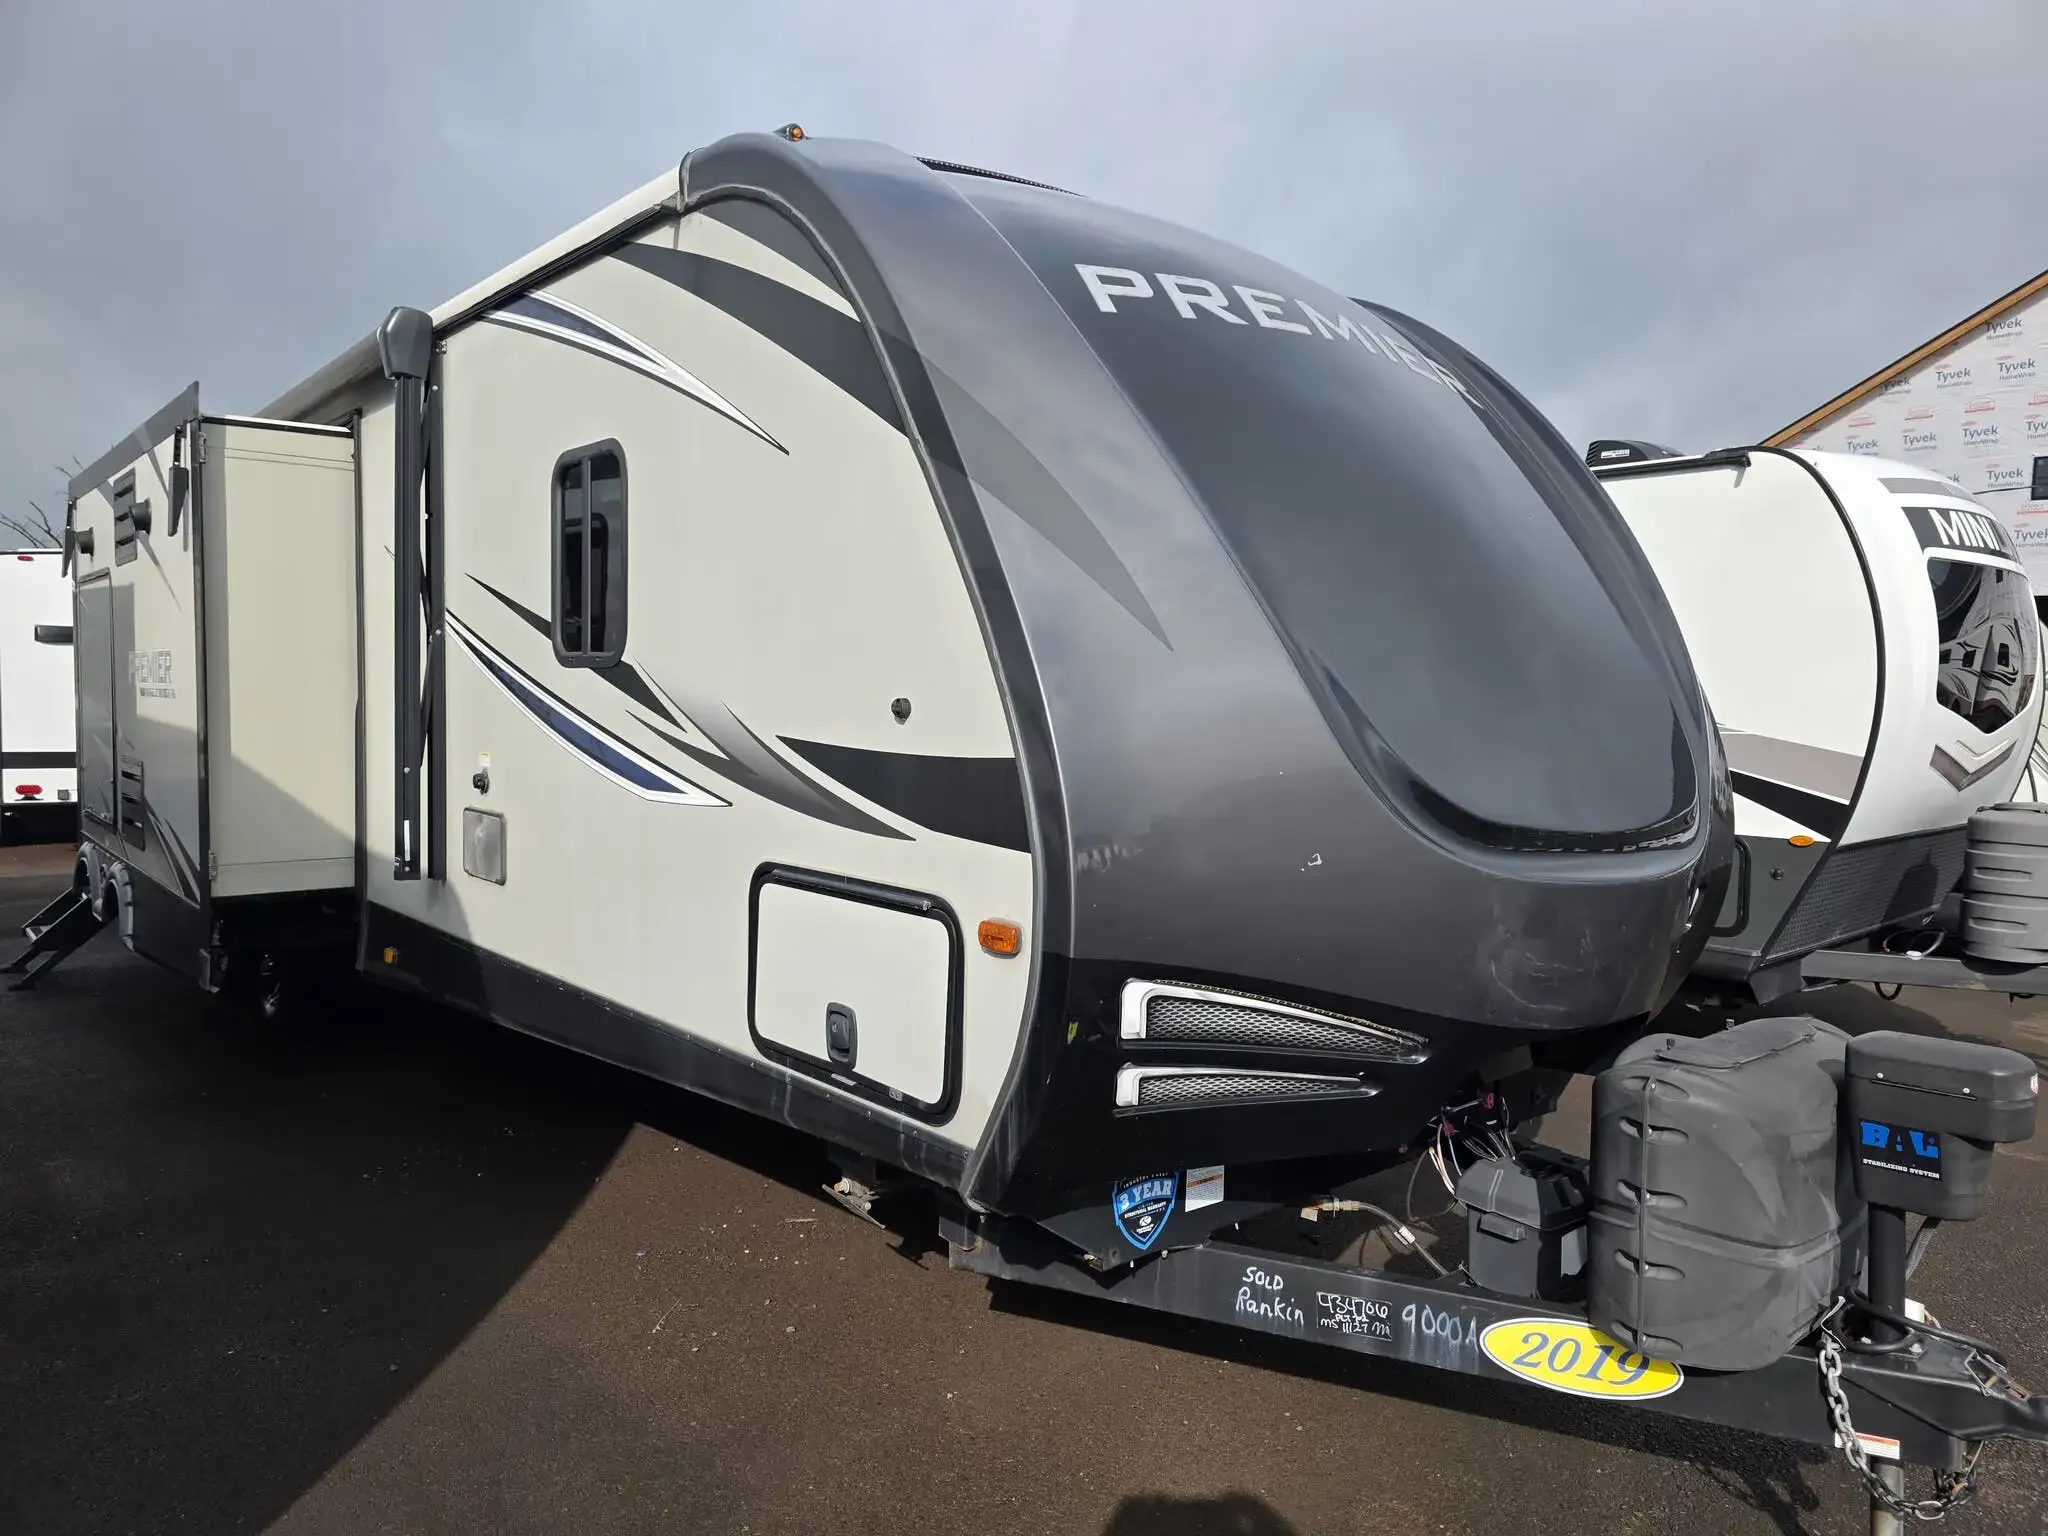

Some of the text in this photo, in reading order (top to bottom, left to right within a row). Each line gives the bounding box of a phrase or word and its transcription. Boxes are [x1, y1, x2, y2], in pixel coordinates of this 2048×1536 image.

[1985, 318, 2023, 333] Tyvek
[1075, 264, 1484, 409] PREMIER
[1997, 358, 2035, 374] Tyvek
[1936, 368, 1971, 383] Tyvek
[1882, 376, 1910, 391] yvek
[1962, 424, 1999, 440] Tyvek
[2026, 420, 2048, 433] Tyv
[1903, 431, 1937, 446] Tyvek
[1847, 440, 1879, 455] Tyvek
[1986, 468, 2024, 482] Tyvek
[1909, 1168, 1940, 1179] SYSTEM
[1132, 1180, 1172, 1203] YEAR
[1242, 1266, 1284, 1290] SOLD
[1236, 1286, 1304, 1326] Rankin
[1512, 1332, 1650, 1386] 2019
